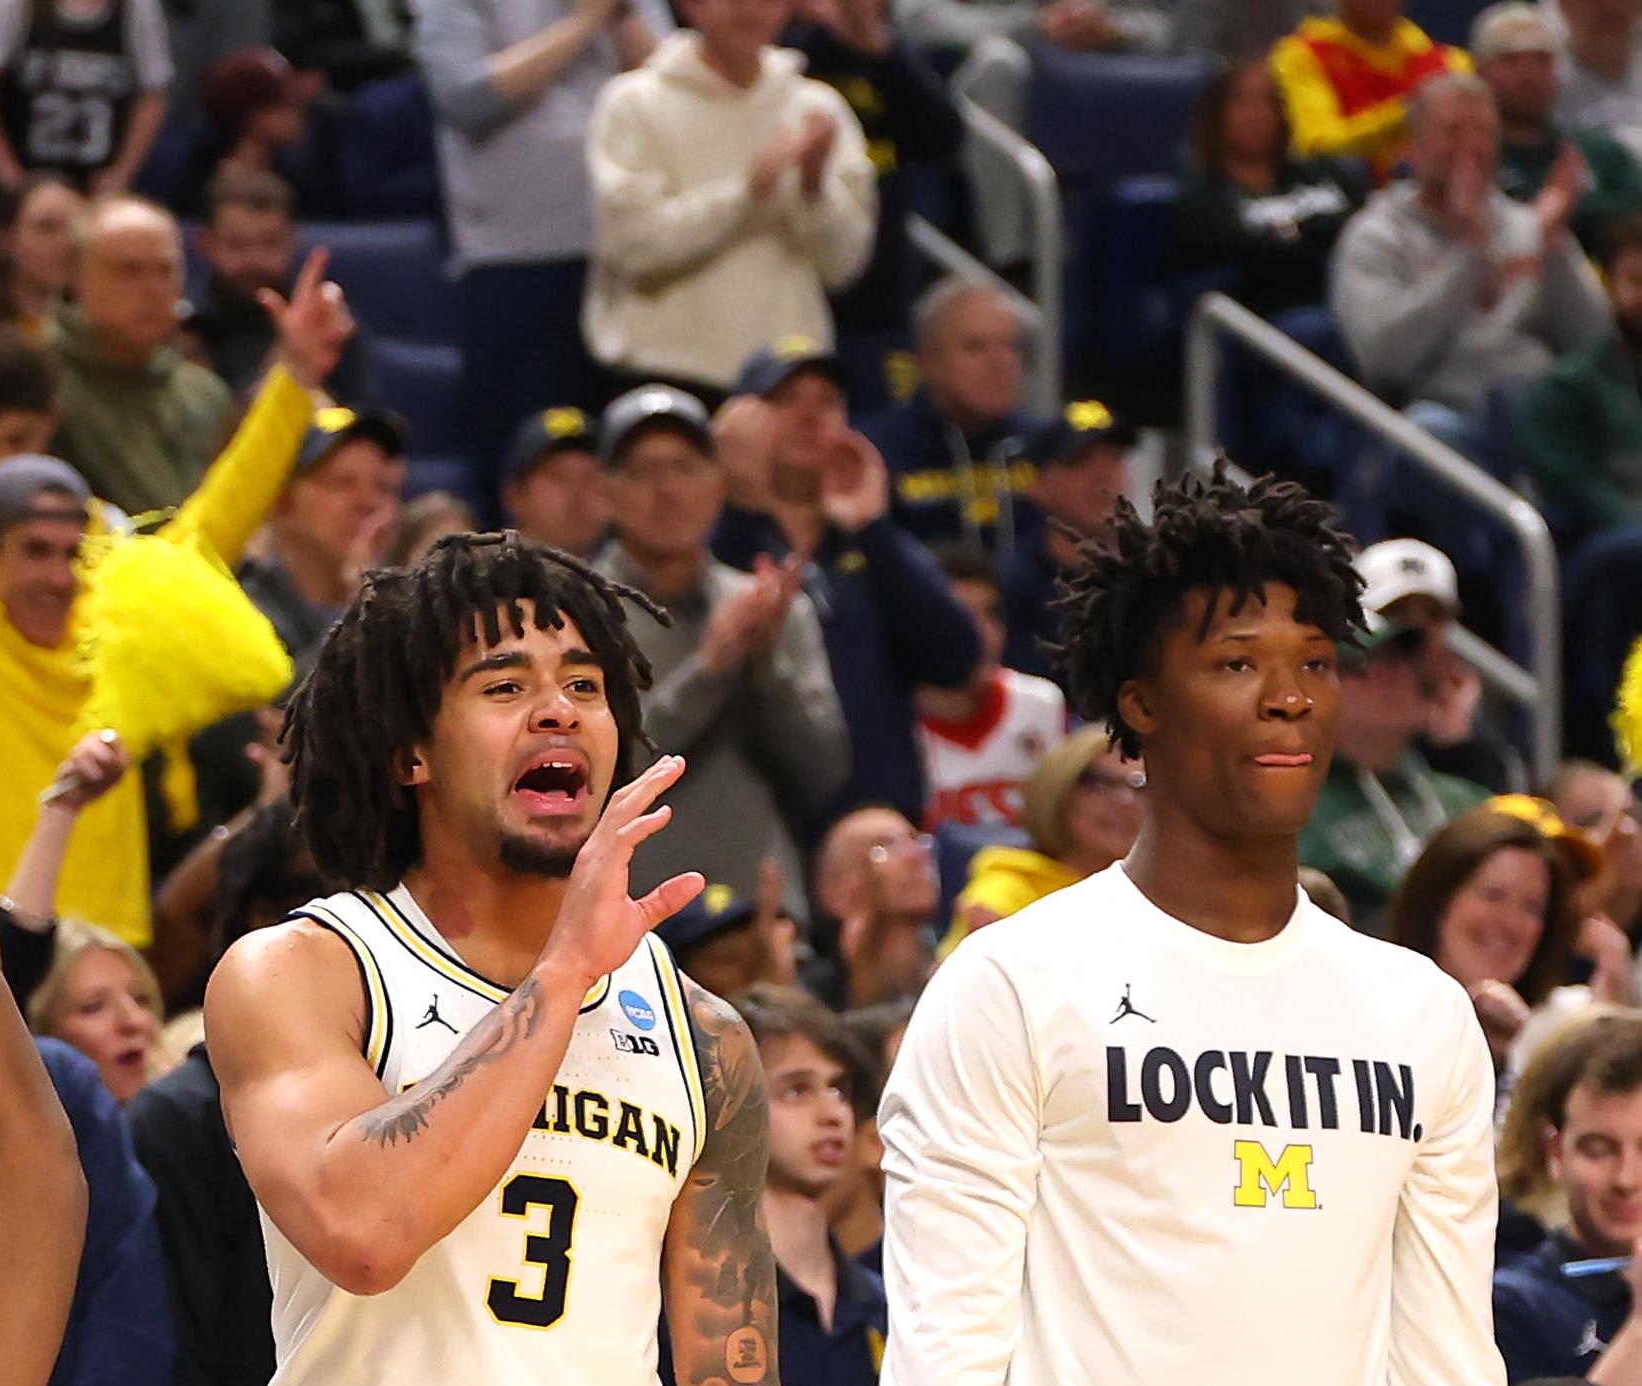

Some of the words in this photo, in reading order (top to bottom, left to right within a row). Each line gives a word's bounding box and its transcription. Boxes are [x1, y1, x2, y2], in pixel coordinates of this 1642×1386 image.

[1106, 1045, 1279, 1128] LOCK
[1284, 1054, 1343, 1130] IT
[1352, 1058, 1424, 1144] IN.
[1234, 1139, 1318, 1210] M
[483, 1171, 581, 1332] 3
